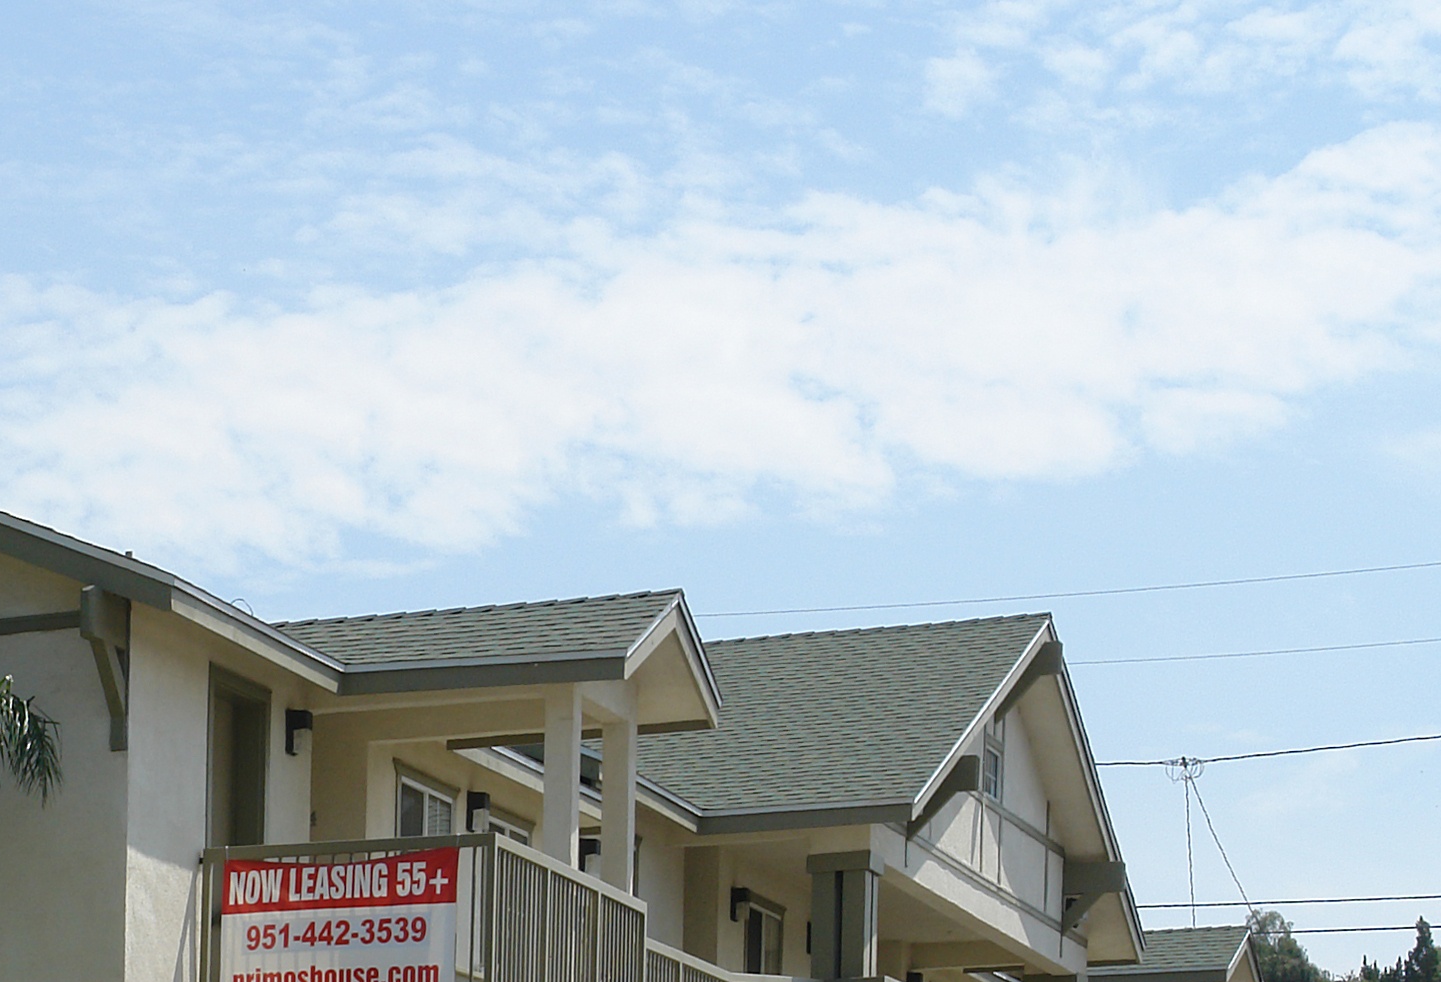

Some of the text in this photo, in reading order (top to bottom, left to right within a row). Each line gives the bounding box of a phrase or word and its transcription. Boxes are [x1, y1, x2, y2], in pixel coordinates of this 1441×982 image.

[229, 861, 449, 905] NOW LEASING 55+
[246, 916, 427, 950] 951-442-3539
